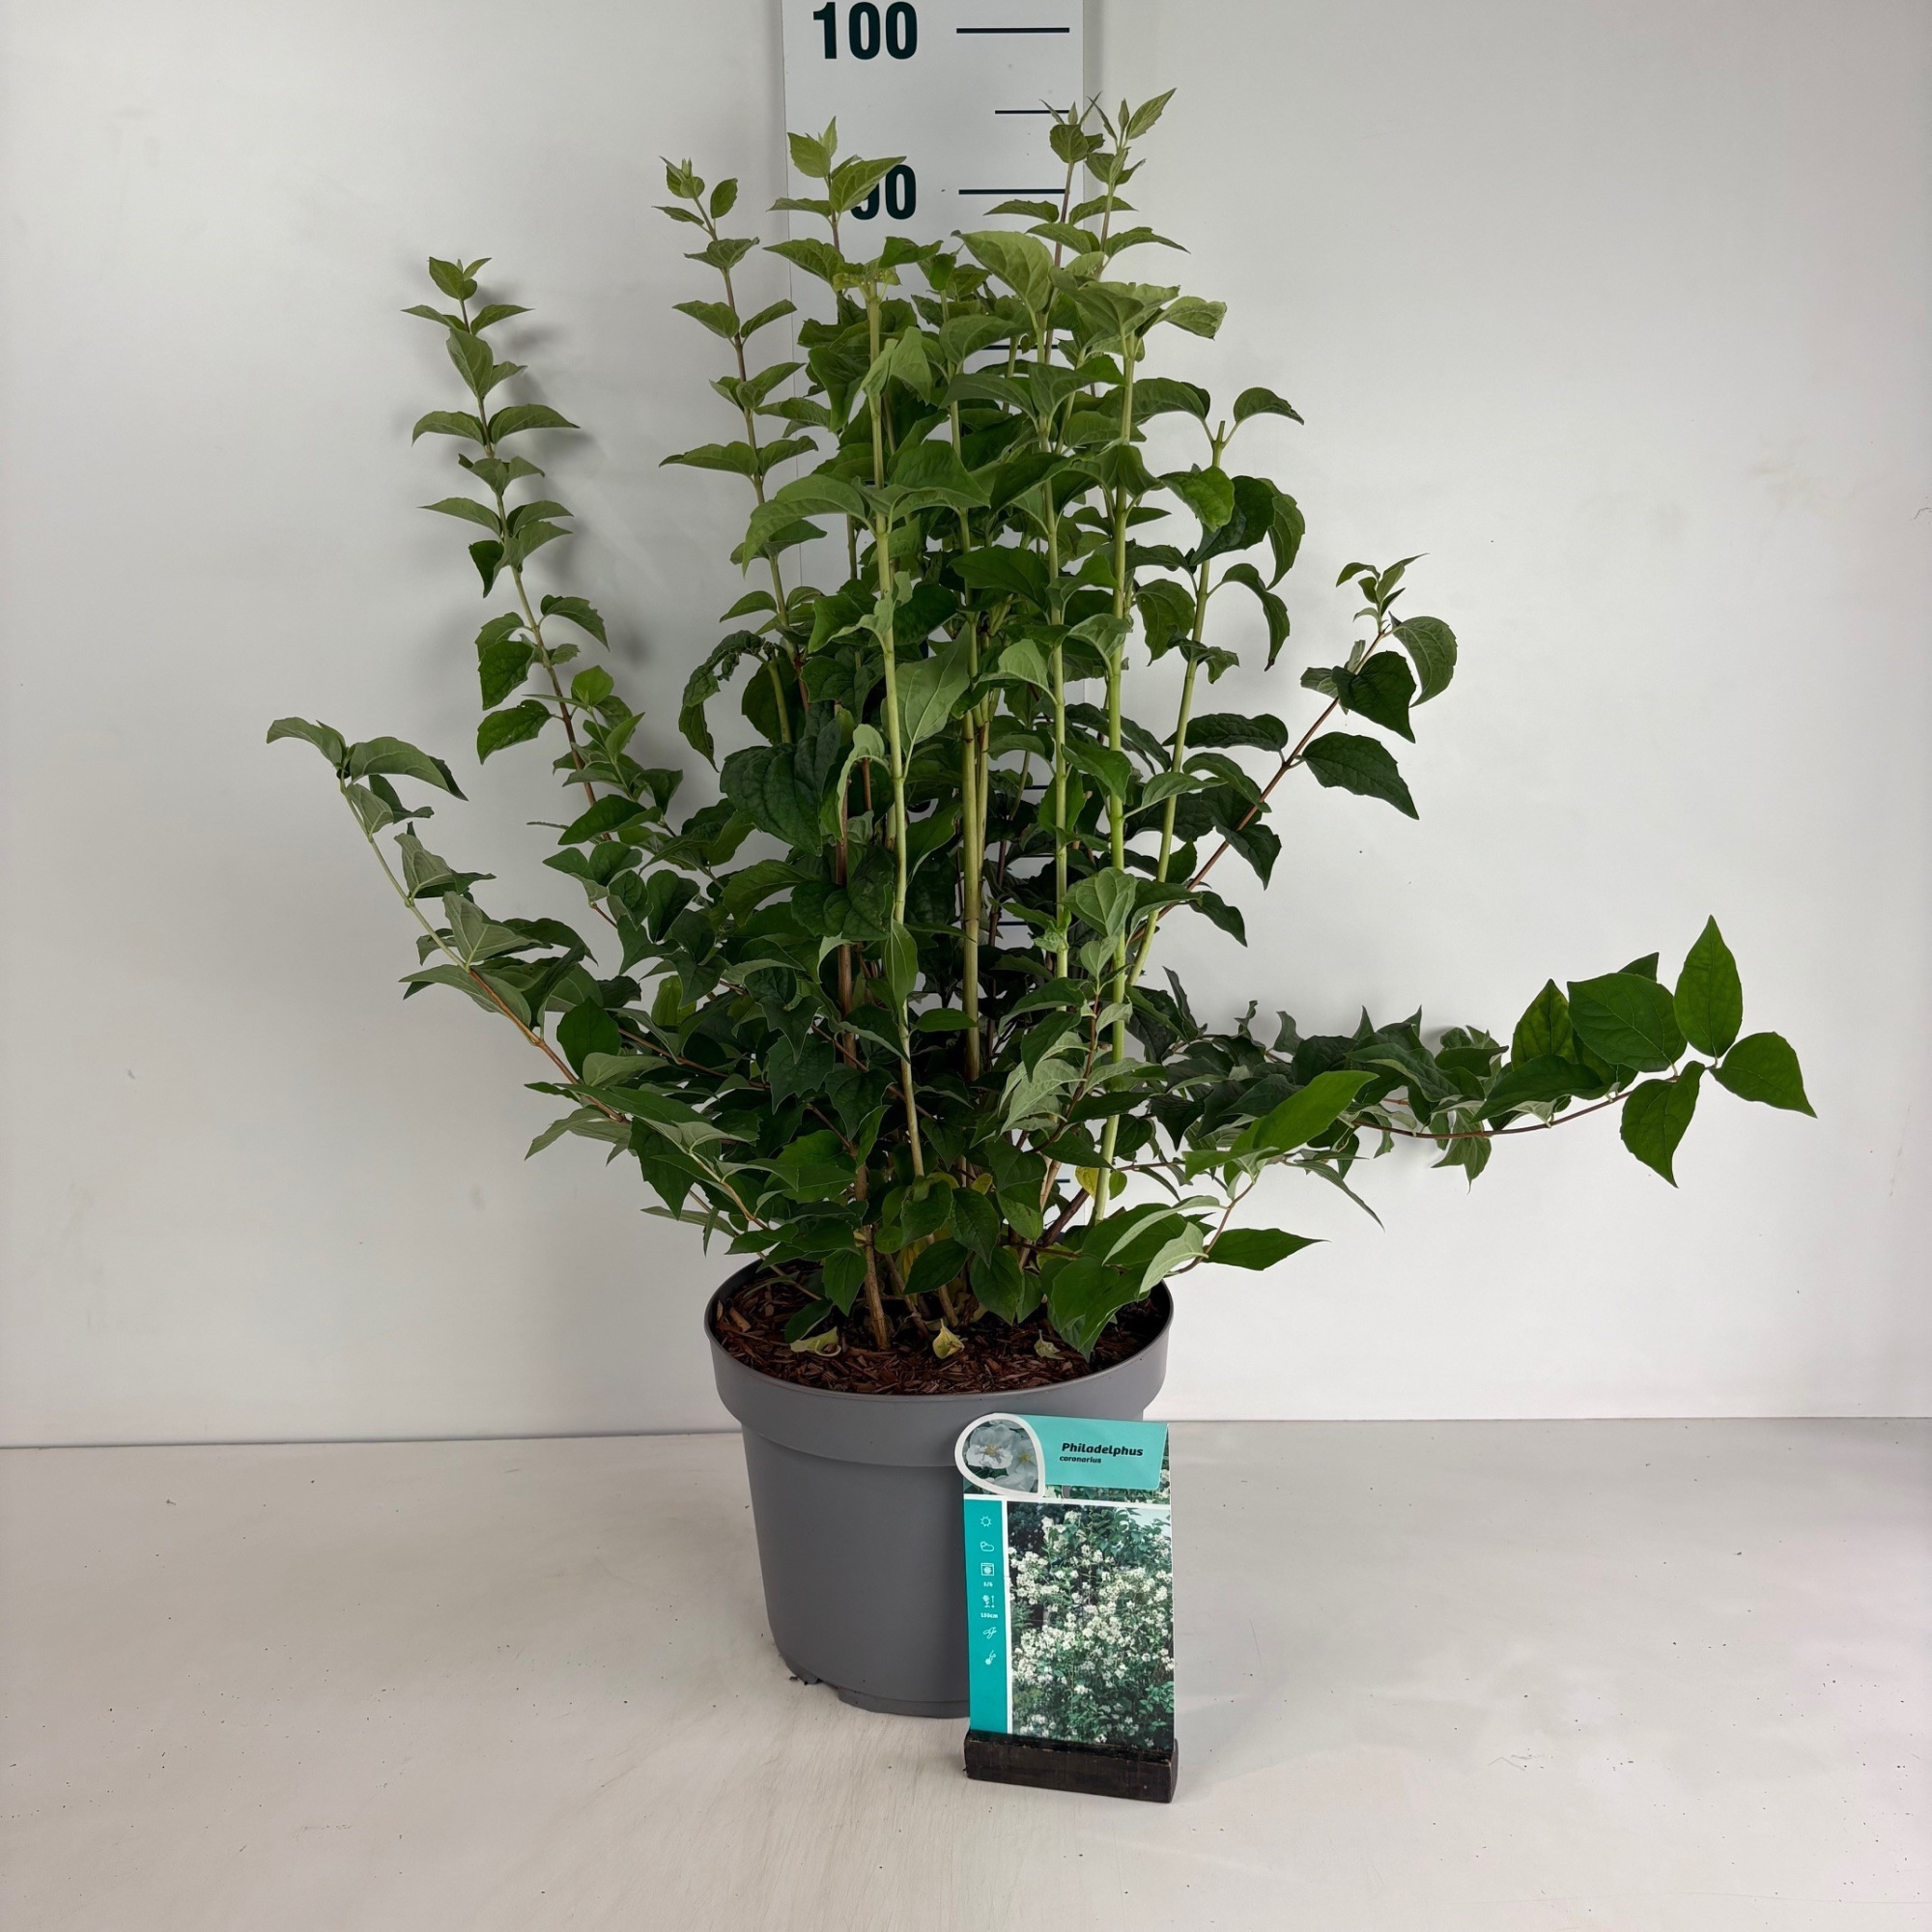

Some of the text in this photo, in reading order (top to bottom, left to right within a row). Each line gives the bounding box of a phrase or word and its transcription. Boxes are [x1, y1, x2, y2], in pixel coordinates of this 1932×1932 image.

[812, 1, 918, 60] 100
[1062, 1442, 1144, 1457] Philadelphus
[1059, 1456, 1102, 1464] coronarius
